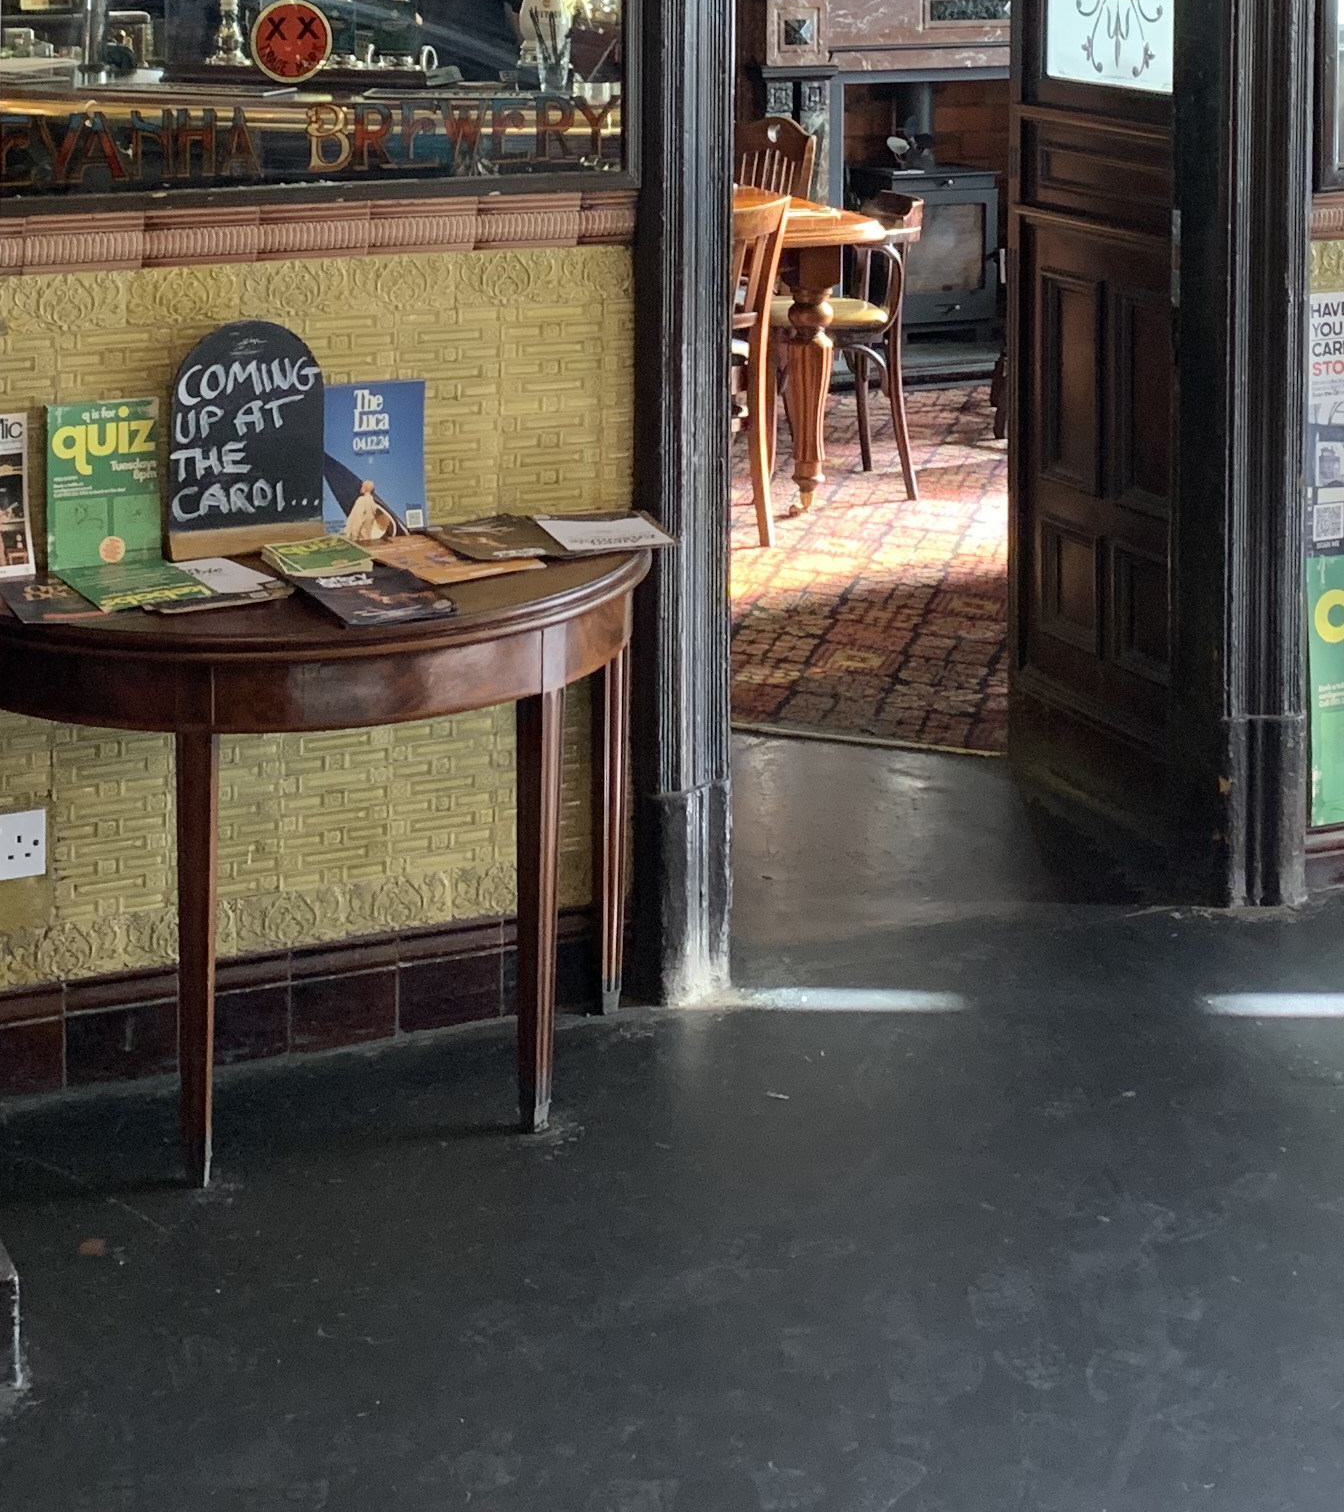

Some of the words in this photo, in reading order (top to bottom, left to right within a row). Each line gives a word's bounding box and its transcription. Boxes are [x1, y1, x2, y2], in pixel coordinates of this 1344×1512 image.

[307, 95, 620, 174] BREWERY
[1312, 322, 1343, 339] YOU
[178, 356, 320, 406] COMING
[353, 389, 383, 411] The
[91, 409, 100, 419] is
[101, 407, 117, 418] for
[175, 406, 224, 444] UP
[234, 394, 304, 436] AT
[353, 410, 389, 432] Luca
[52, 406, 156, 475] quiz
[170, 441, 252, 482] THE
